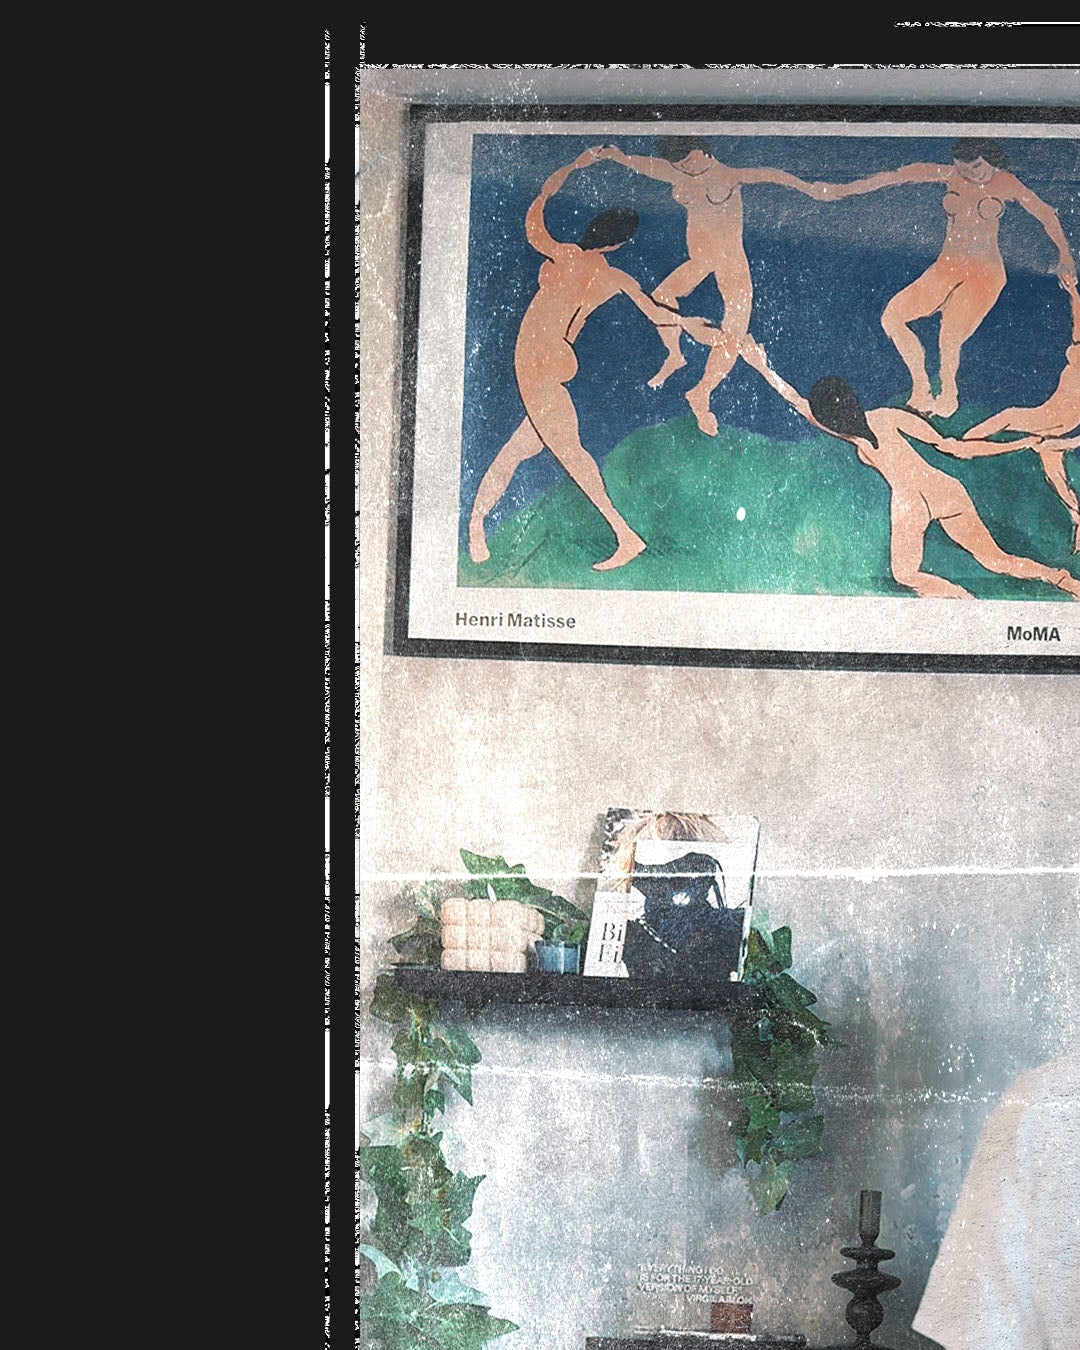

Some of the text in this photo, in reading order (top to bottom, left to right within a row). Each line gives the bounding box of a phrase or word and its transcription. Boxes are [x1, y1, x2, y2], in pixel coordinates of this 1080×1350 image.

[455, 612, 576, 628] Henri Matisse
[1007, 626, 1061, 641] MoMA
[671, 1274, 692, 1283] THE
